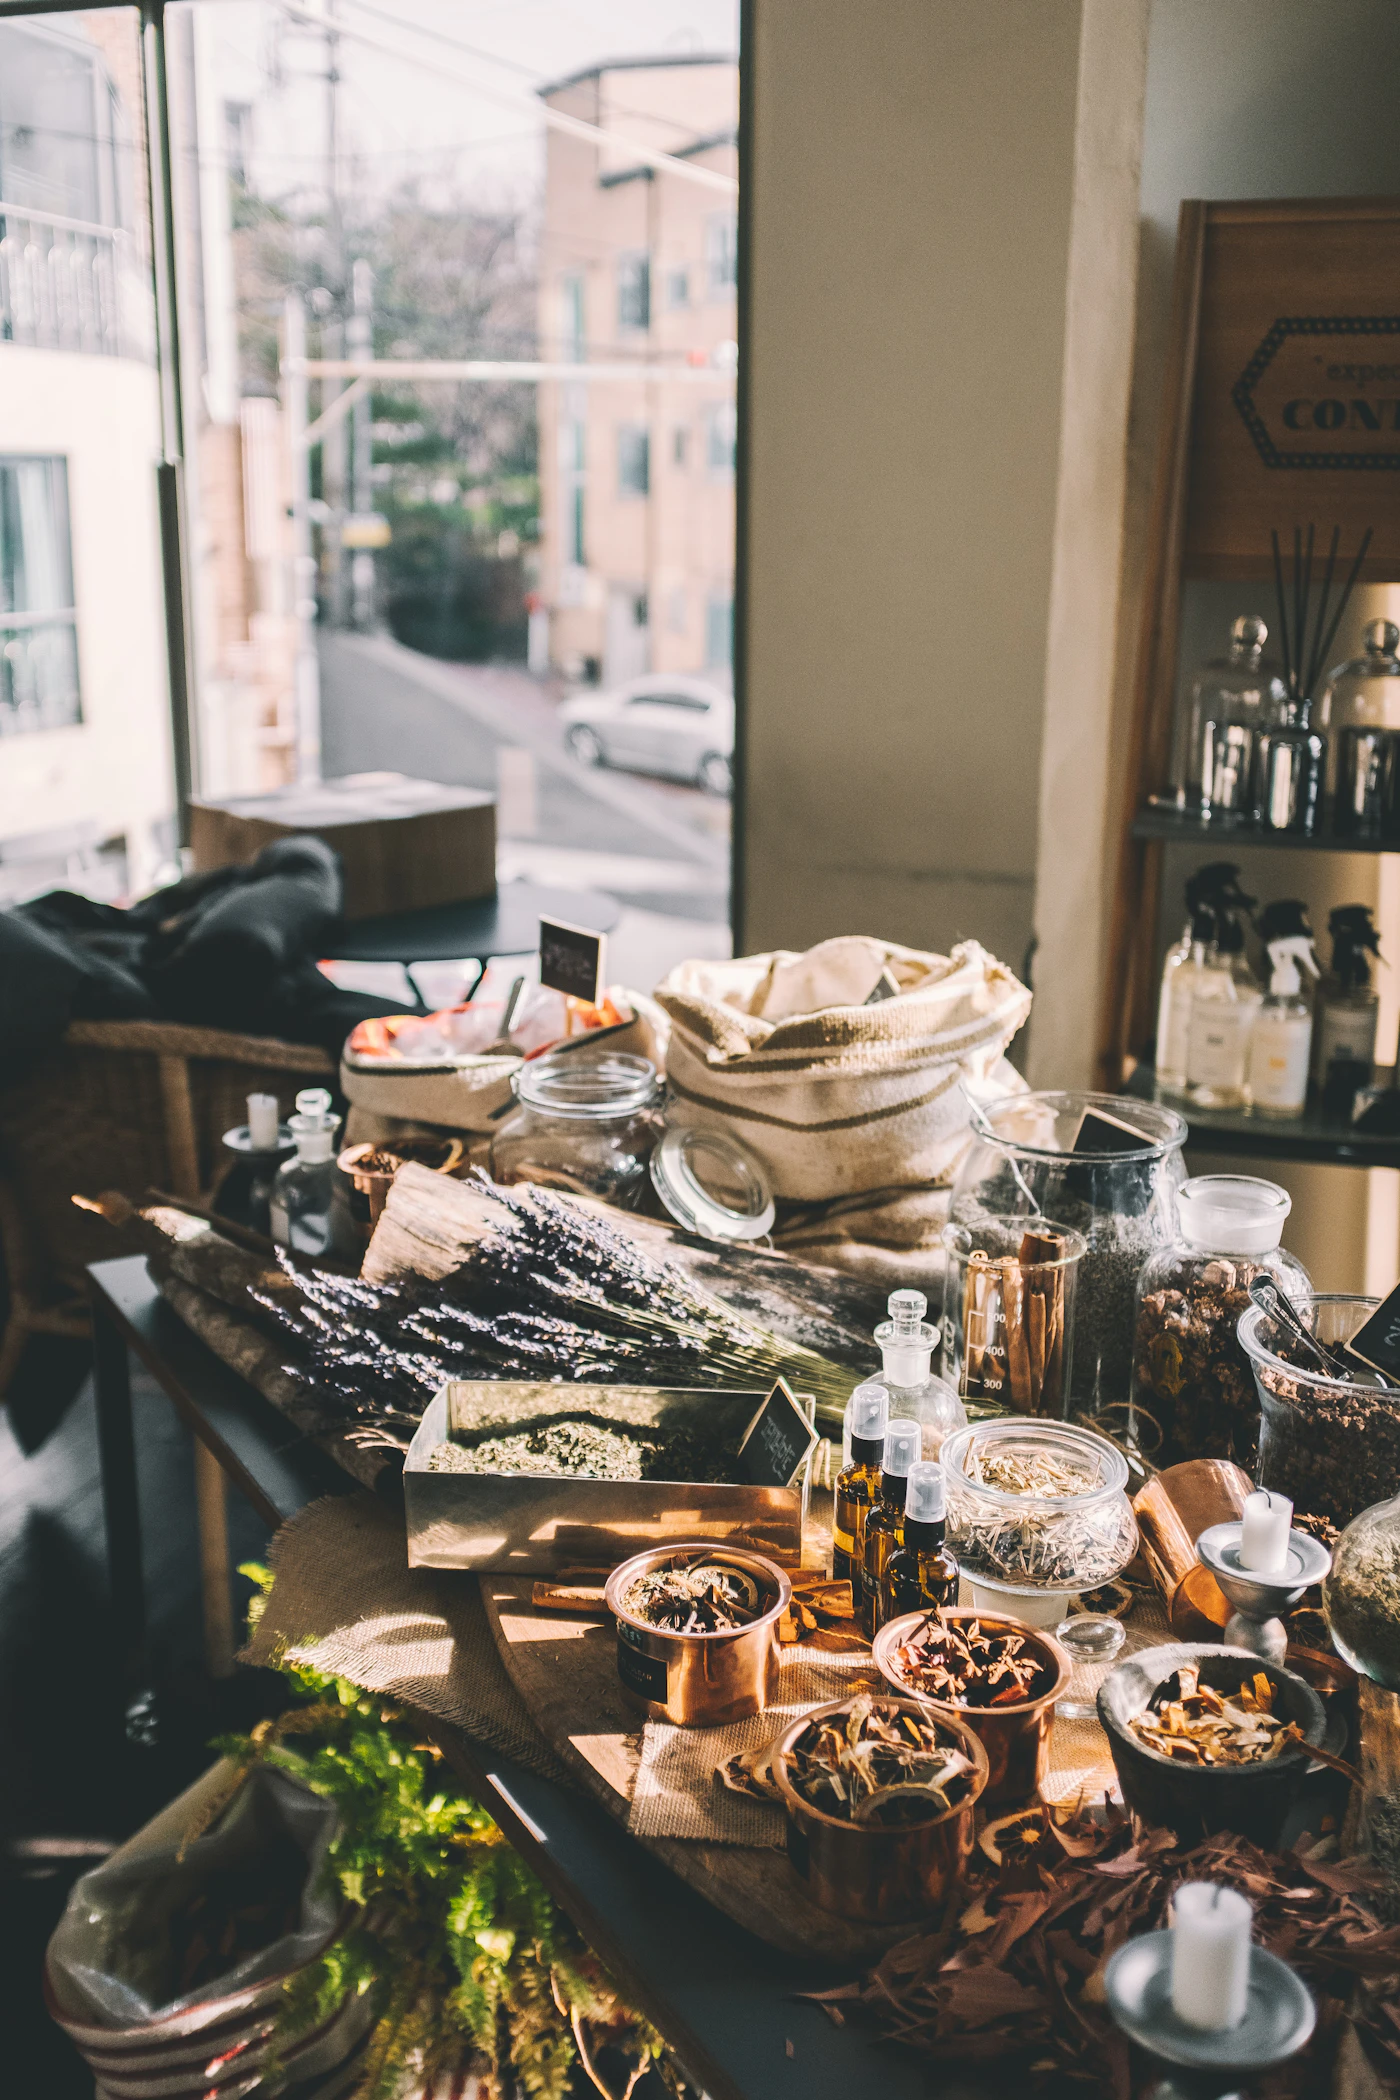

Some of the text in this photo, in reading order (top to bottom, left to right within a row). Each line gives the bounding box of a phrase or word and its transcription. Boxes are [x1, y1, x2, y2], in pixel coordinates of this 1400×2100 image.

[1283, 398, 1400, 430] CON
[987, 1312, 1006, 1323] 500
[984, 1345, 1005, 1356] 400
[983, 1378, 1003, 1390] 300
